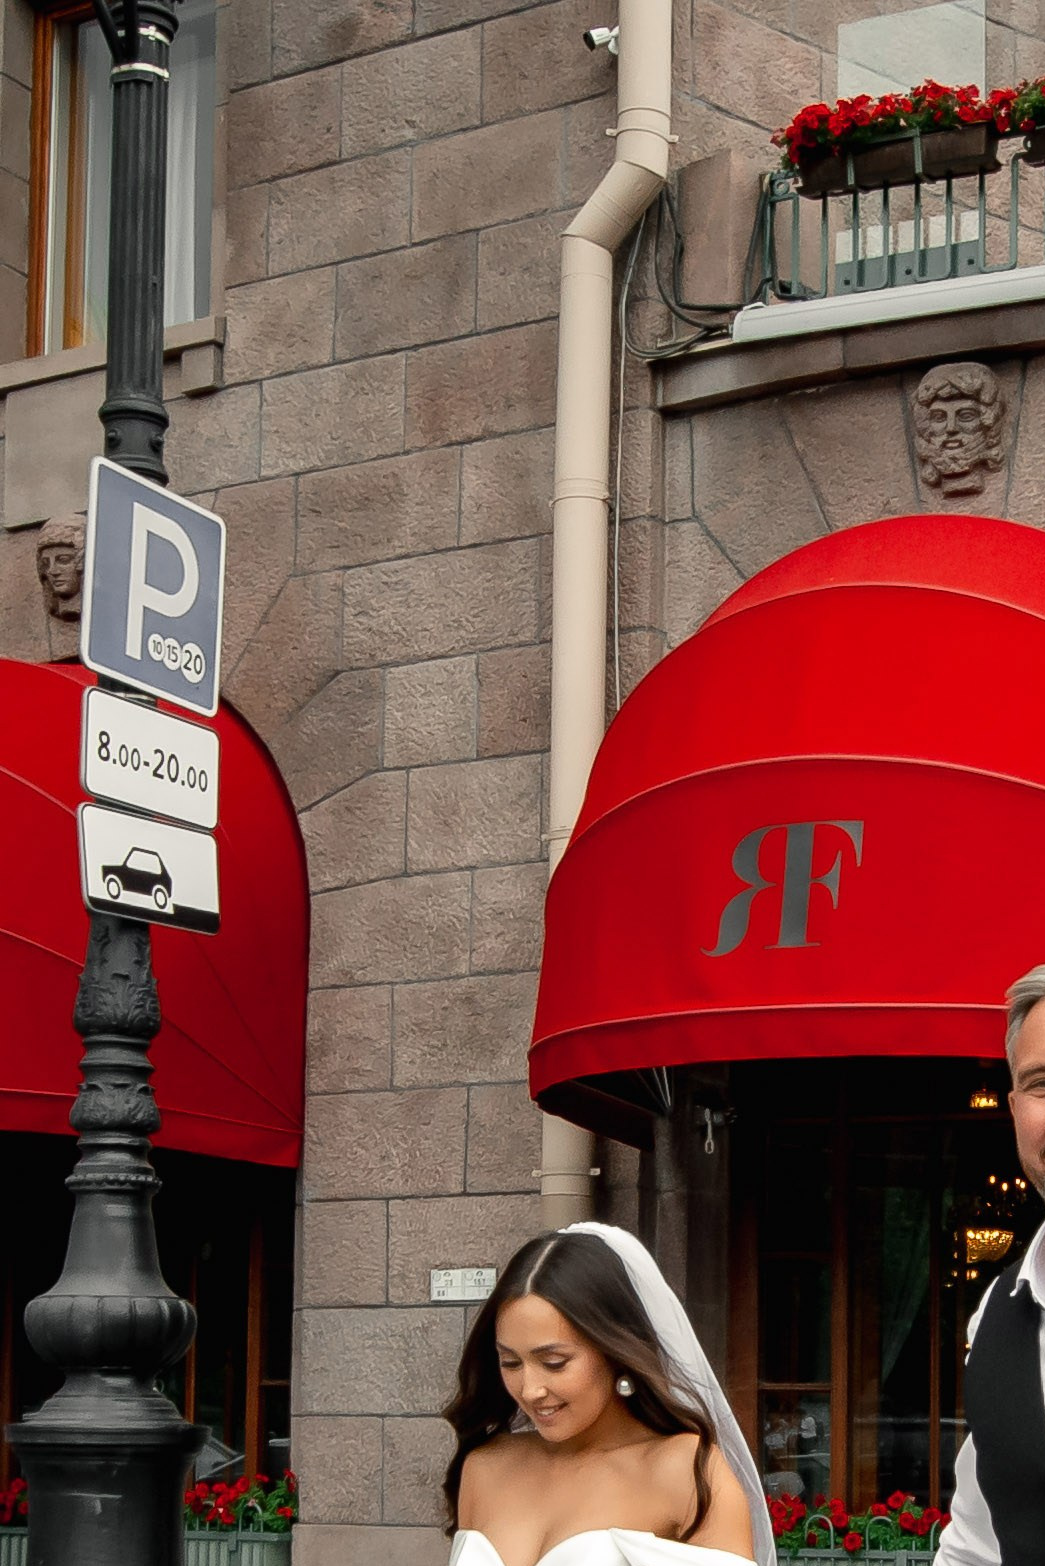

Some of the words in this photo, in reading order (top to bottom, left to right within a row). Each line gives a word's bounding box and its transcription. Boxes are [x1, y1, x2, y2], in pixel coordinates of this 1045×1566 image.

[125, 501, 199, 661] P
[152, 639, 163, 655] 10
[166, 644, 179, 663] 15
[183, 649, 203, 675] 20
[97, 730, 208, 792] 8.00-20.00
